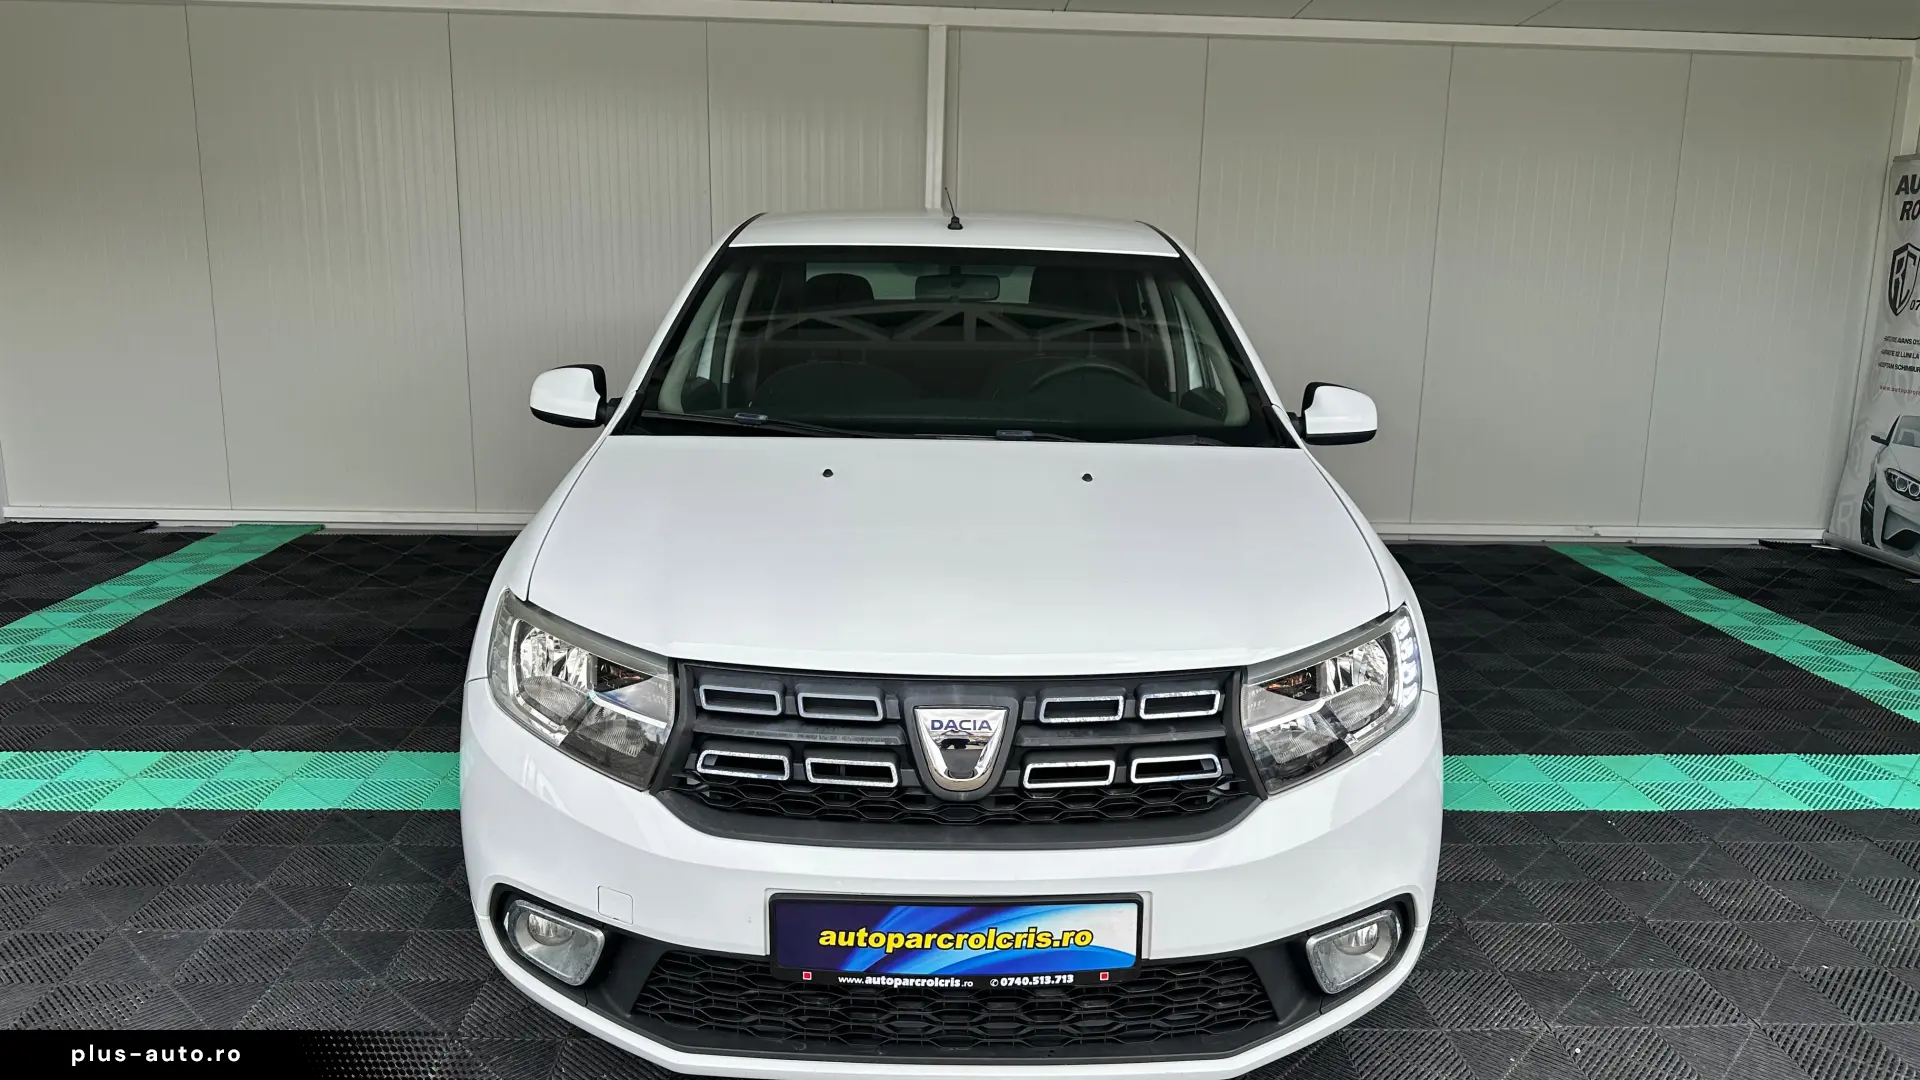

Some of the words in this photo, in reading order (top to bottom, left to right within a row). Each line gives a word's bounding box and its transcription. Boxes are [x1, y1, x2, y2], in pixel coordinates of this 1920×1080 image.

[930, 719, 992, 731] DACIA
[818, 927, 1094, 954] autoparcrolcris.ro
[838, 974, 974, 988] www.autoparcrolcris.ro
[1000, 974, 1074, 987] 0740.513.713
